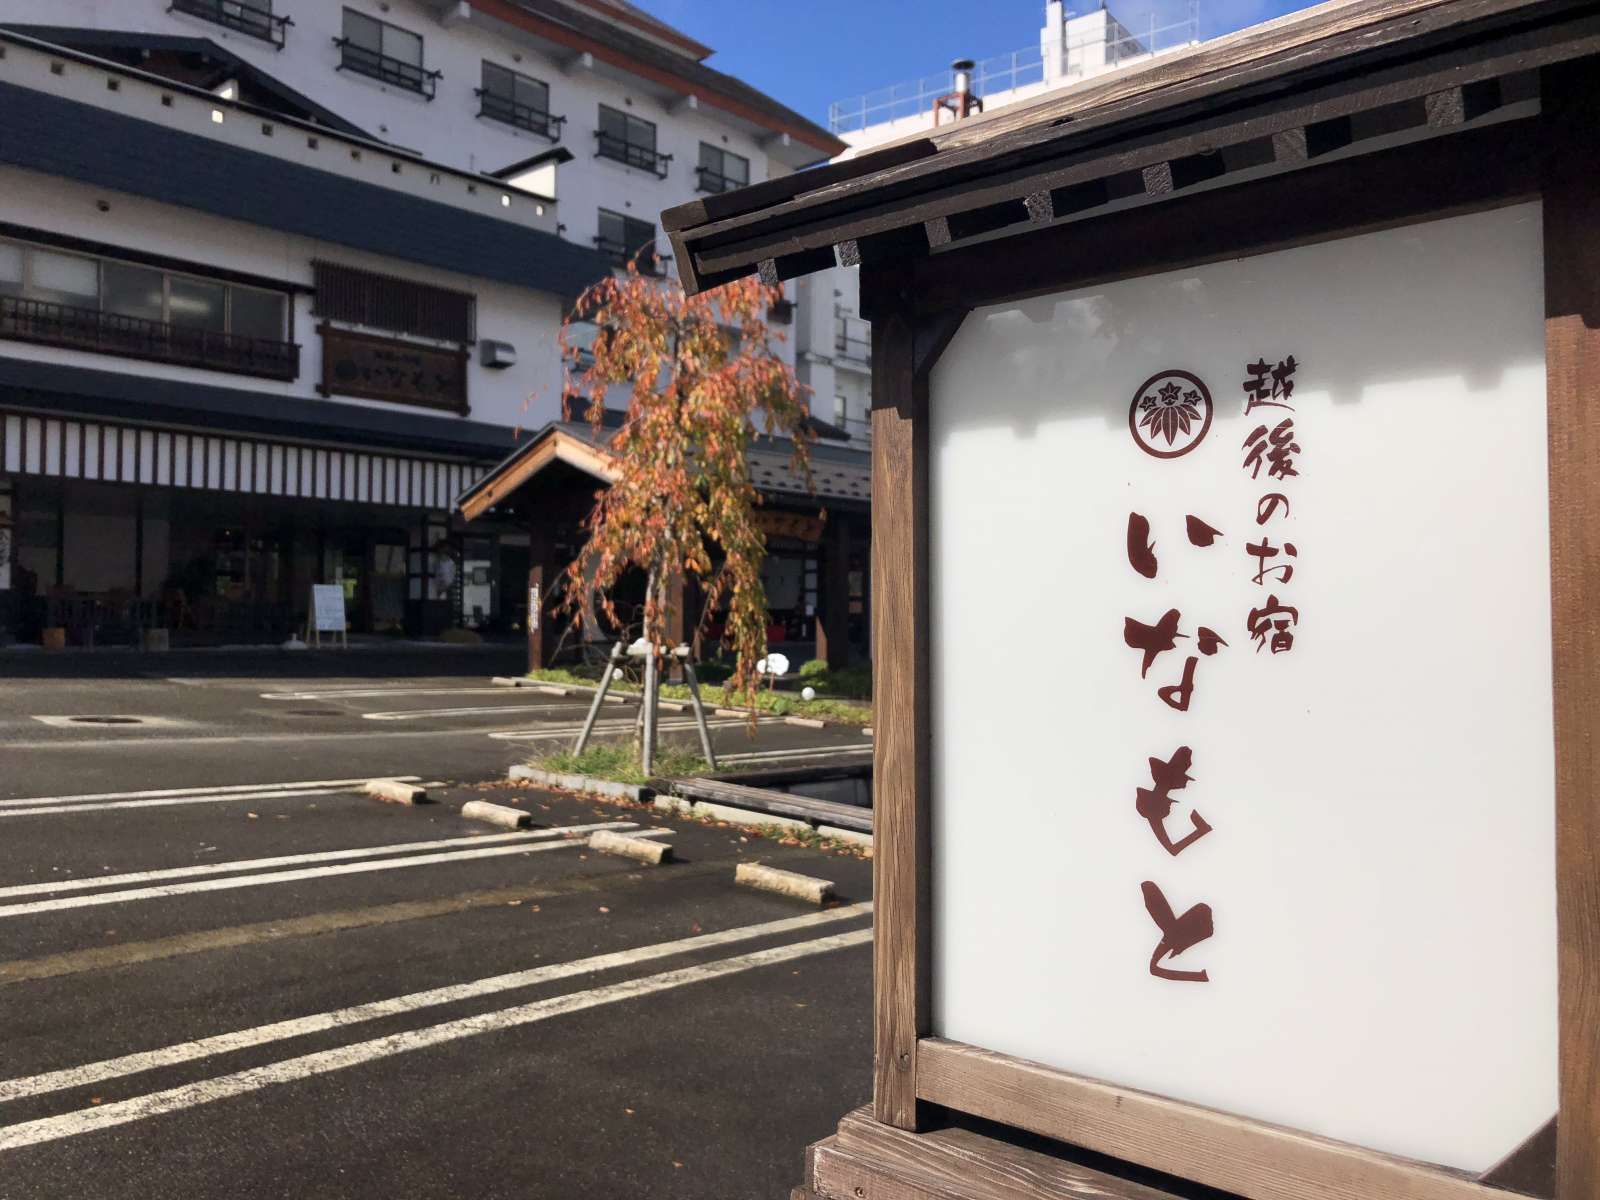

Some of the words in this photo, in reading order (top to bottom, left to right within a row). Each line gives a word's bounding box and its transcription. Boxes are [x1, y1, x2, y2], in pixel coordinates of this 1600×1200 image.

[1242, 355, 1301, 655] 越後のお宿
[1123, 511, 1230, 983] いなもと
